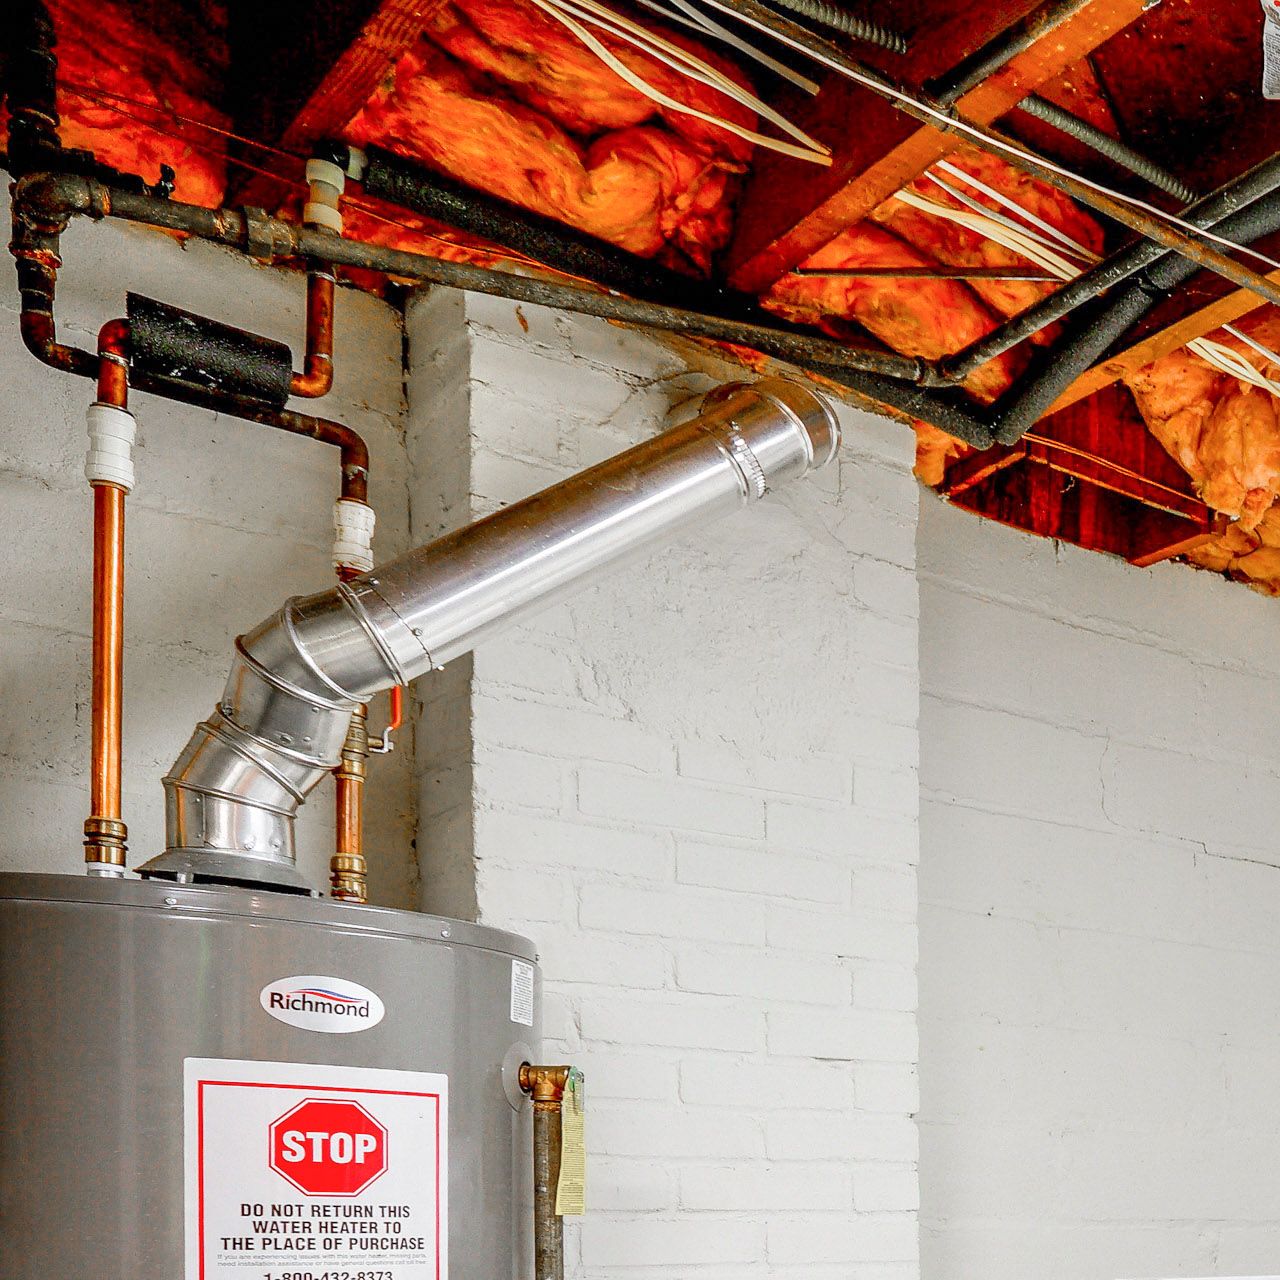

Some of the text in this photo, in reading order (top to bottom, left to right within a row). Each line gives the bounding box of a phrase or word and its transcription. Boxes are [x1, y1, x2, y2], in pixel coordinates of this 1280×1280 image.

[269, 992, 370, 1018] Richmond
[282, 1130, 377, 1164] STOP
[240, 1203, 411, 1218] DO NOT RETURN THIS
[253, 1220, 402, 1234] WATER HEATER TO
[220, 1238, 425, 1251] THE PLACE OF PURCHASE
